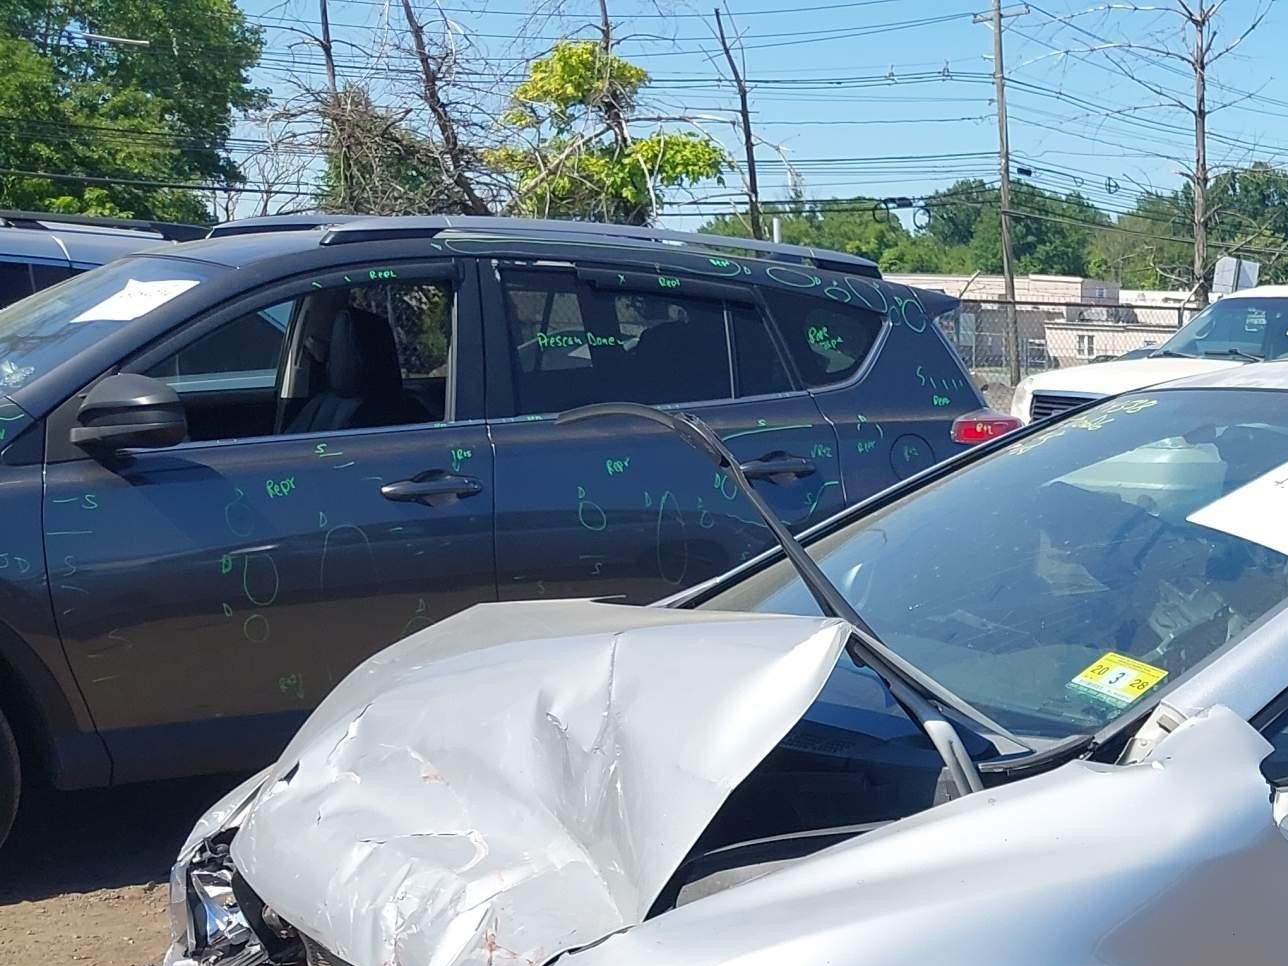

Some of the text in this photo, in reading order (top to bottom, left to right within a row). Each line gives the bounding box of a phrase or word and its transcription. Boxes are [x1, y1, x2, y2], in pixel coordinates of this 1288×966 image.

[537, 332, 583, 351] Prescan
[1091, 664, 1110, 676] 20
[1109, 672, 1126, 685] 3
[1129, 678, 1149, 691] 28
